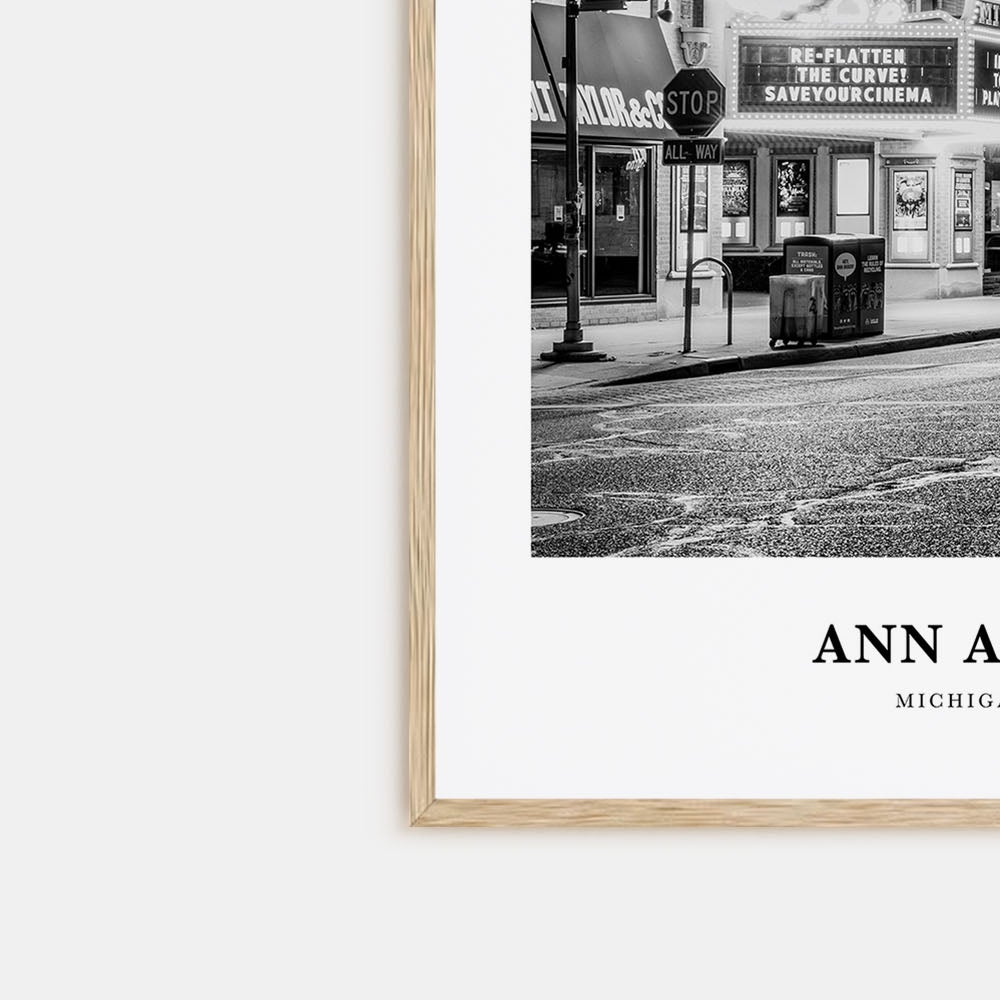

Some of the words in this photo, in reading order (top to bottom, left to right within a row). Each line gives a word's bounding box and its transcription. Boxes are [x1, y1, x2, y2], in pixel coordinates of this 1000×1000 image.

[791, 47, 906, 65] RE-FLATTEN
[797, 67, 831, 83] THE
[839, 67, 907, 83] CURVE!
[531, 80, 557, 122] LT
[667, 90, 718, 115] STOP
[764, 86, 932, 103] SAVEYOURCINEMA
[695, 144, 718, 159] WAY
[812, 623, 943, 664] ANN
